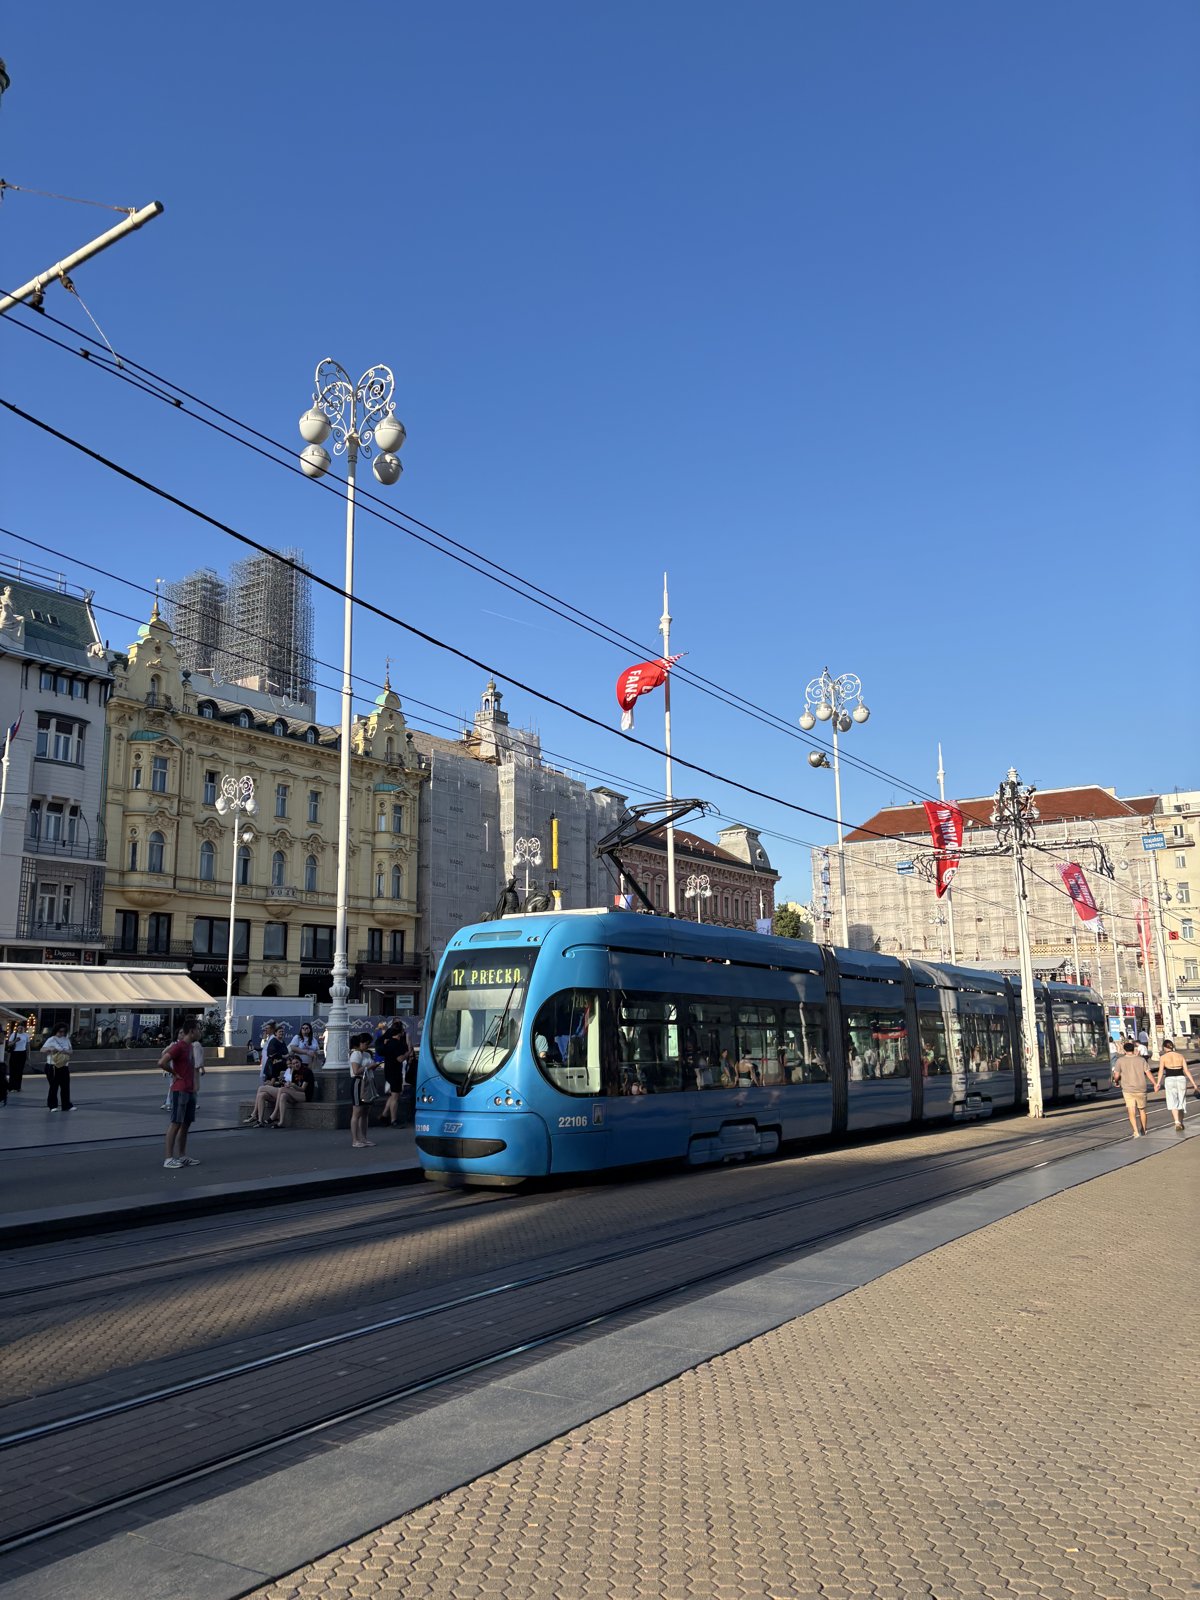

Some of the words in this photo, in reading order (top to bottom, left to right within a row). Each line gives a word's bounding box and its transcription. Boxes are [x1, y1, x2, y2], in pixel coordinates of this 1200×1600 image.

[625, 670, 642, 701] FANS
[1170, 931, 1177, 940] S
[54, 949, 76, 958] Dogma
[453, 969, 465, 985] 17
[443, 1122, 463, 1133] ZET
[558, 1116, 588, 1128] 22106
